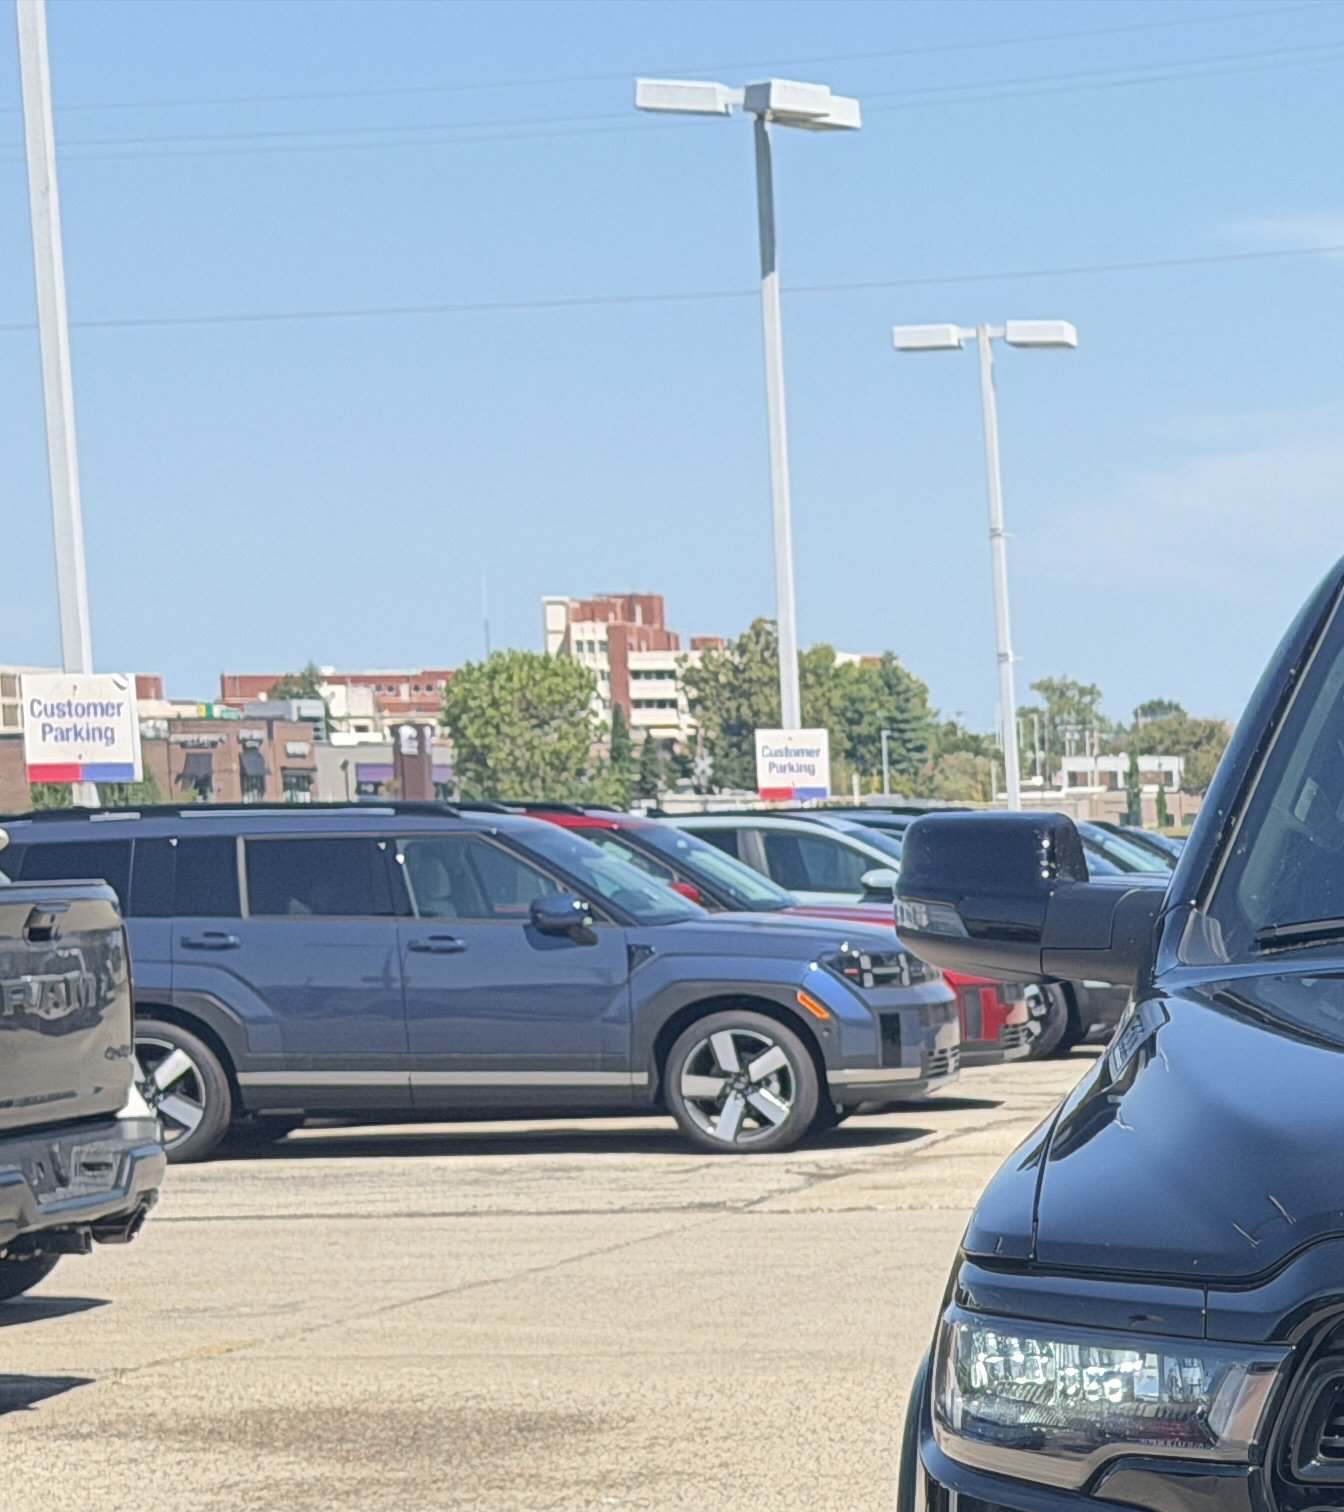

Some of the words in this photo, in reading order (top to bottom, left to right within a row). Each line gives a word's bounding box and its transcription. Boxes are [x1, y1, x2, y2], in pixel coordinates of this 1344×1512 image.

[30, 699, 124, 718] Customer
[41, 722, 115, 746] Parking
[762, 745, 821, 758] Customer
[768, 761, 815, 776] Parking
[2, 972, 97, 1016] RAM
